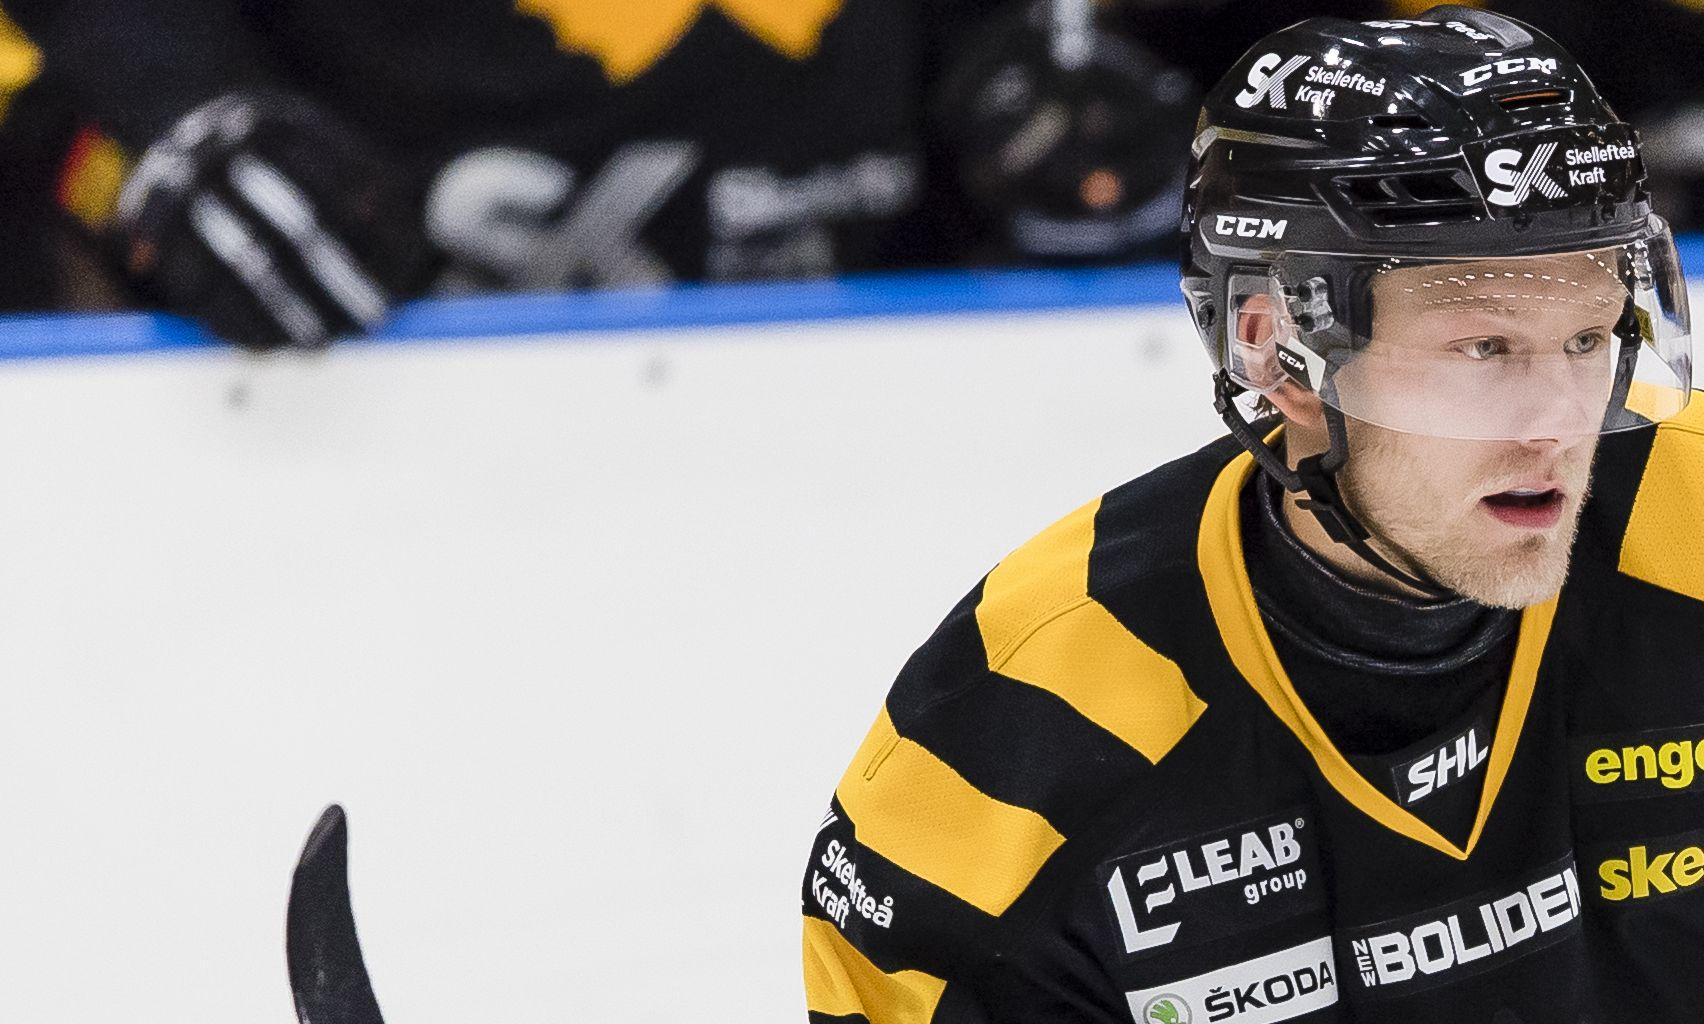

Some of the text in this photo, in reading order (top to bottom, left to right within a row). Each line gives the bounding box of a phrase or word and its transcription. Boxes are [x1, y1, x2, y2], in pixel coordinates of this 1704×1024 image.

[1305, 66, 1386, 96] Skellefteå
[1459, 58, 1557, 86] CCM
[1295, 85, 1336, 105] Kraft
[1566, 140, 1635, 166] Skellefteå
[1568, 167, 1607, 187] Kraft
[1215, 215, 1288, 240] CCM
[1278, 350, 1305, 371] CCM
[1407, 728, 1489, 803] SHL
[812, 869, 850, 930] Kraft
[1244, 868, 1307, 905] group
[1368, 861, 1582, 985] BOLIDEN
[1351, 938, 1377, 988] NEW
[1204, 961, 1335, 1023] ŠKODA
